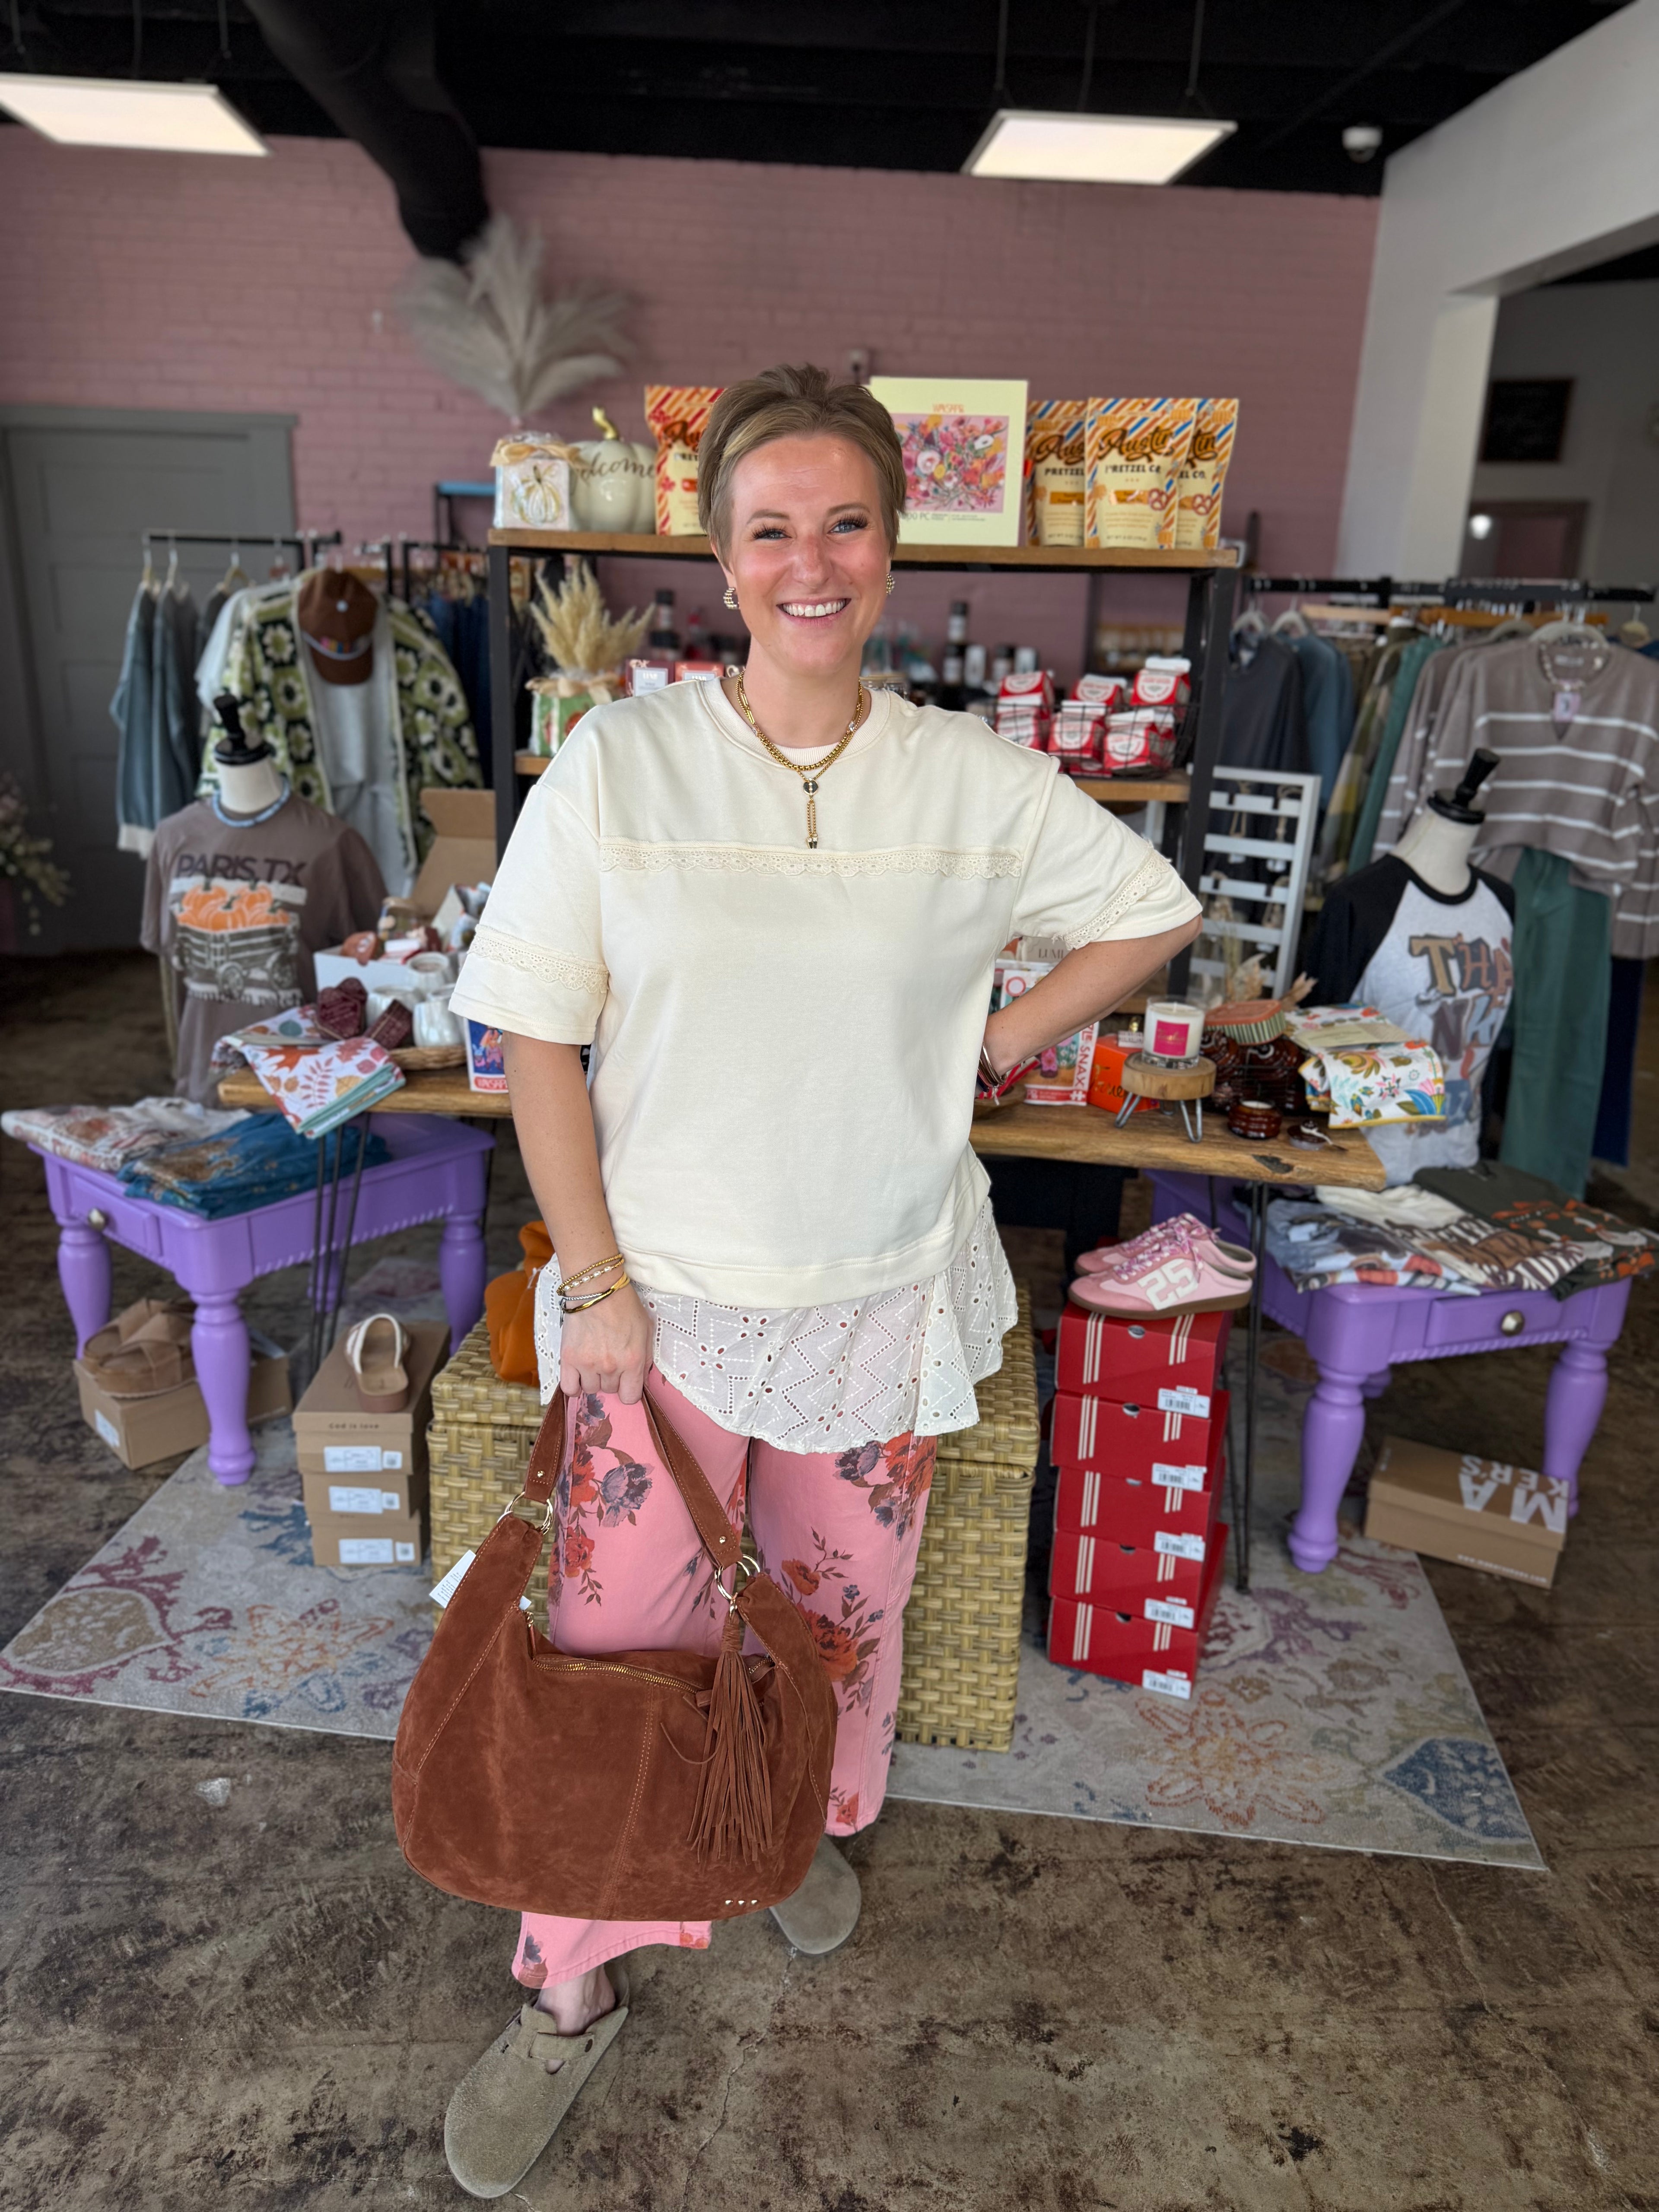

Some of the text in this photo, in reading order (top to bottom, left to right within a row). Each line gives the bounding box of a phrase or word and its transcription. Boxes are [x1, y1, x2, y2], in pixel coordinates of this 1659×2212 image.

[1098, 426, 1176, 463] Austin
[1105, 464, 1146, 474] PRETZEL
[264, 858, 308, 887] TX
[1039, 948, 1064, 959] LUMI
[1075, 1045, 1091, 1087] SNAX
[1137, 1258, 1199, 1310] 25
